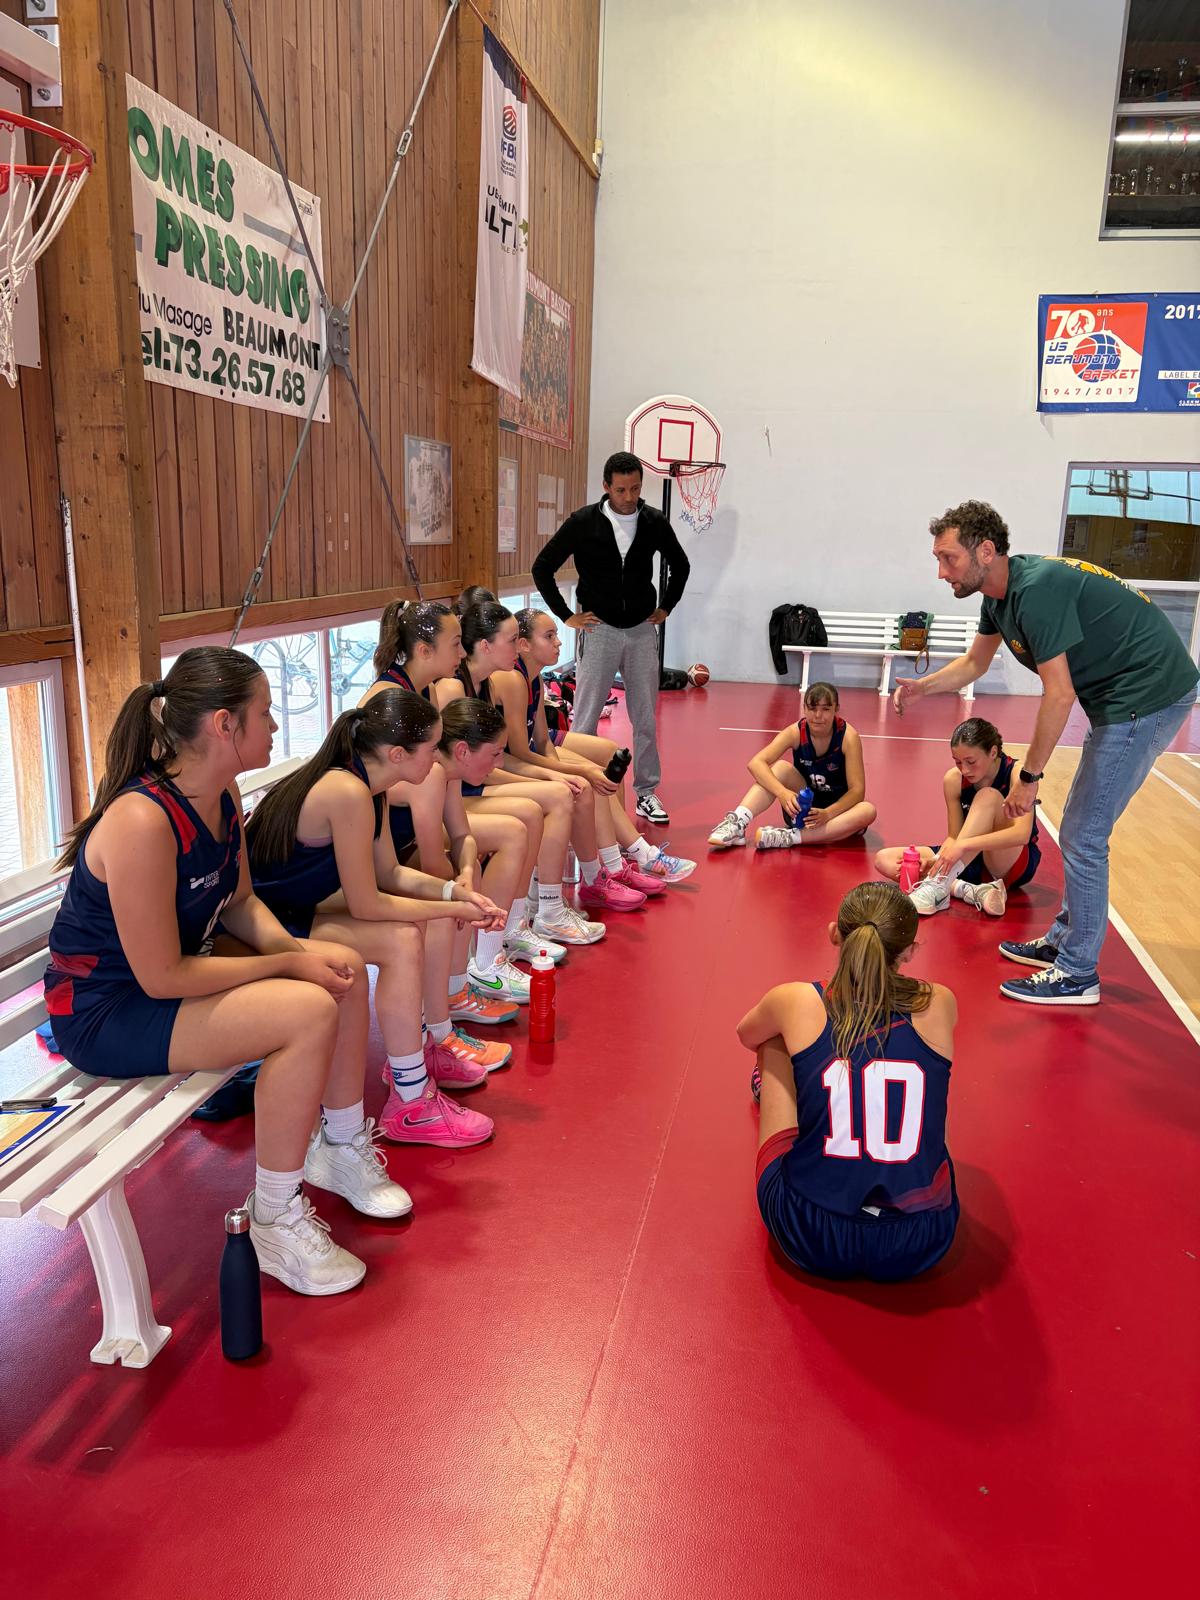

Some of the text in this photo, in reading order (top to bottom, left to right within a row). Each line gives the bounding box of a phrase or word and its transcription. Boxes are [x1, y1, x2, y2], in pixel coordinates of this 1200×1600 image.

[155, 198, 310, 324] PRESSING
[153, 293, 212, 337] Masage
[223, 306, 320, 371] BEAUMONT
[1051, 309, 1114, 338] 70 ans
[1045, 355, 1120, 364] BEAUMONT
[1049, 342, 1068, 351] US
[1082, 369, 1138, 380] BASKET
[822, 1058, 926, 1163] 10
